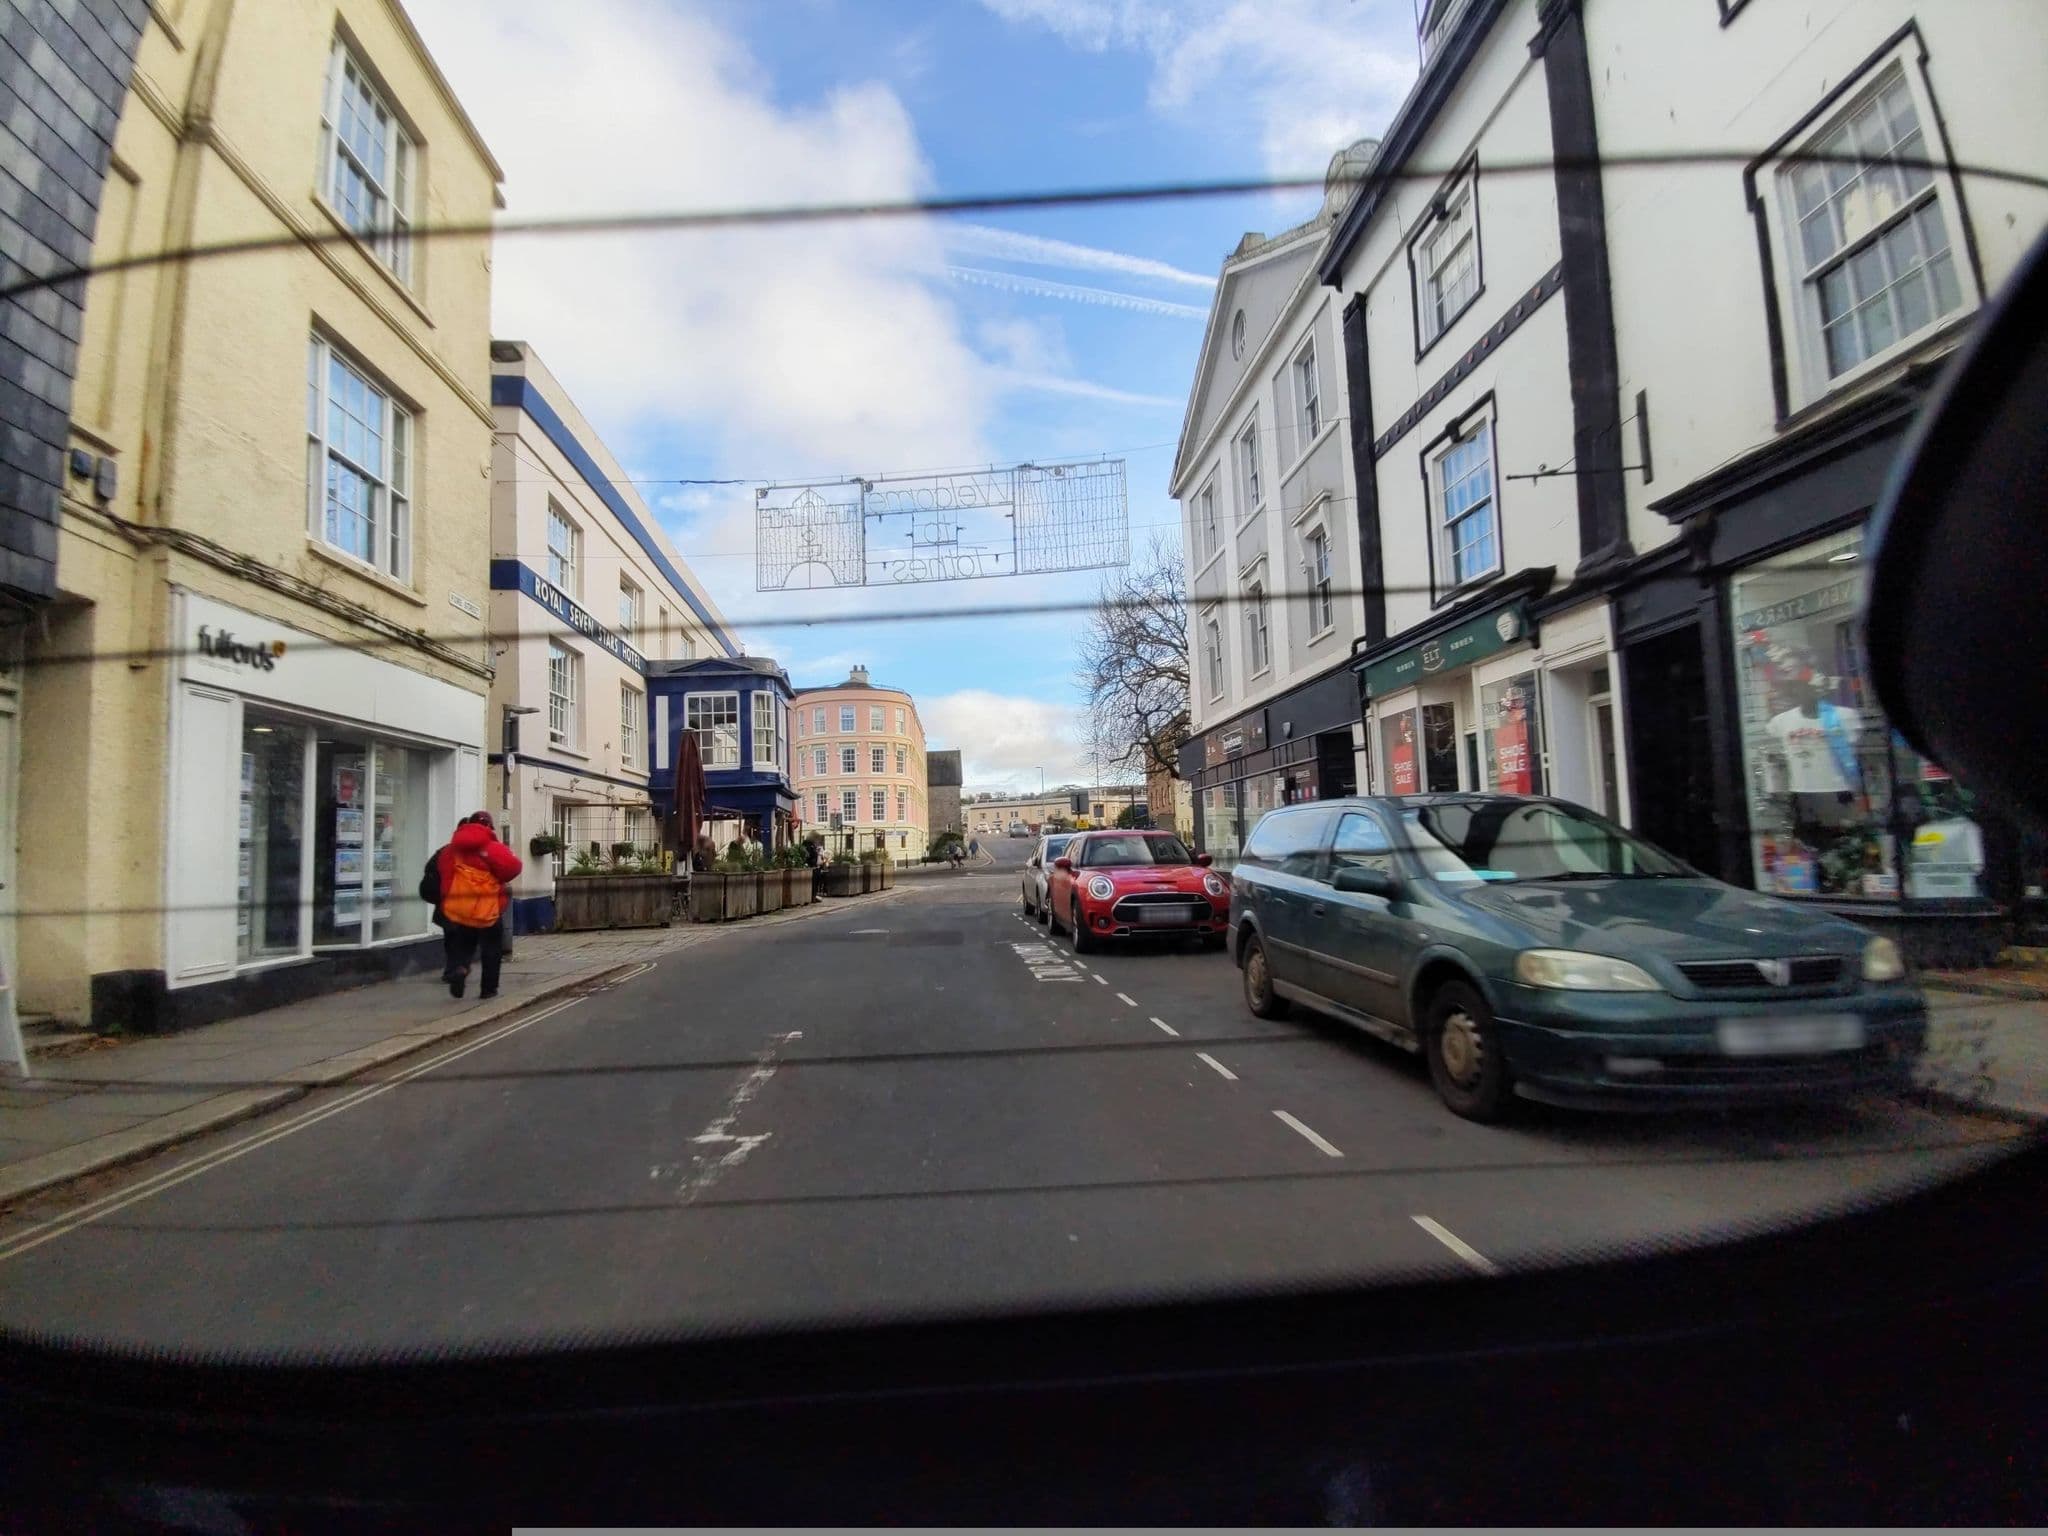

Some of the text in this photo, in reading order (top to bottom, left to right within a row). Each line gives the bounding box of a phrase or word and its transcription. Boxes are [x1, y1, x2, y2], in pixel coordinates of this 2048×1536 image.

[535, 576, 641, 670] ROYAL SEVEN STARS HOTEL
[198, 625, 274, 672] fulfords
[1423, 648, 1440, 664] ELT
[1499, 743, 1526, 760] SHOE
[1394, 760, 1414, 773] SHOE
[1501, 759, 1527, 774] SALE
[1395, 773, 1414, 785] SALE
